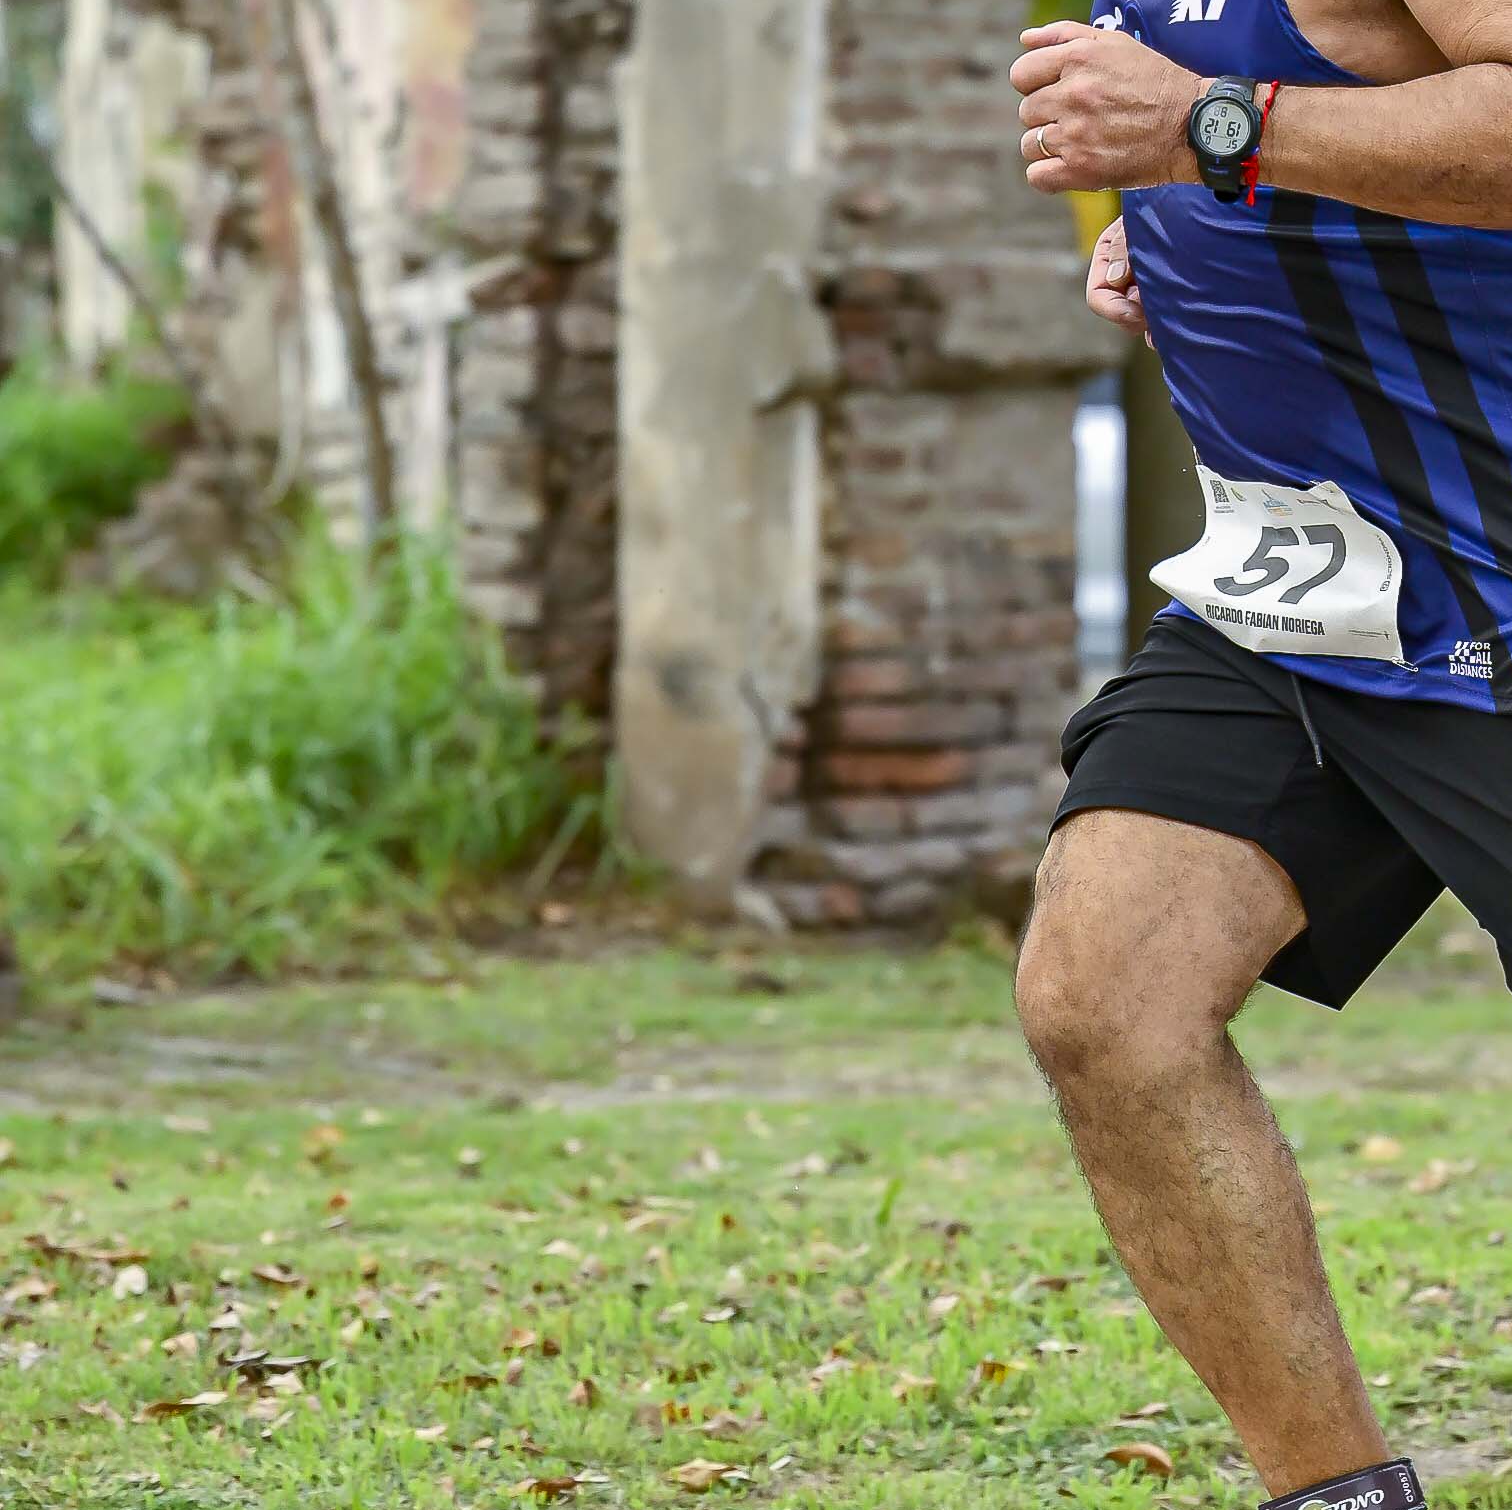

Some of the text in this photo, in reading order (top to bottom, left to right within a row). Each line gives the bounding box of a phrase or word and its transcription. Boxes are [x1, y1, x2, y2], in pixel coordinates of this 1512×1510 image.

[1213, 524, 1346, 604] 57
[1205, 604, 1243, 625] RICARDO
[1245, 610, 1280, 631] FABIAN
[1281, 618, 1326, 636] NORIEGA
[1469, 641, 1491, 651] FOR
[1476, 651, 1493, 665] ALL
[1449, 662, 1493, 679] DISTANCES
